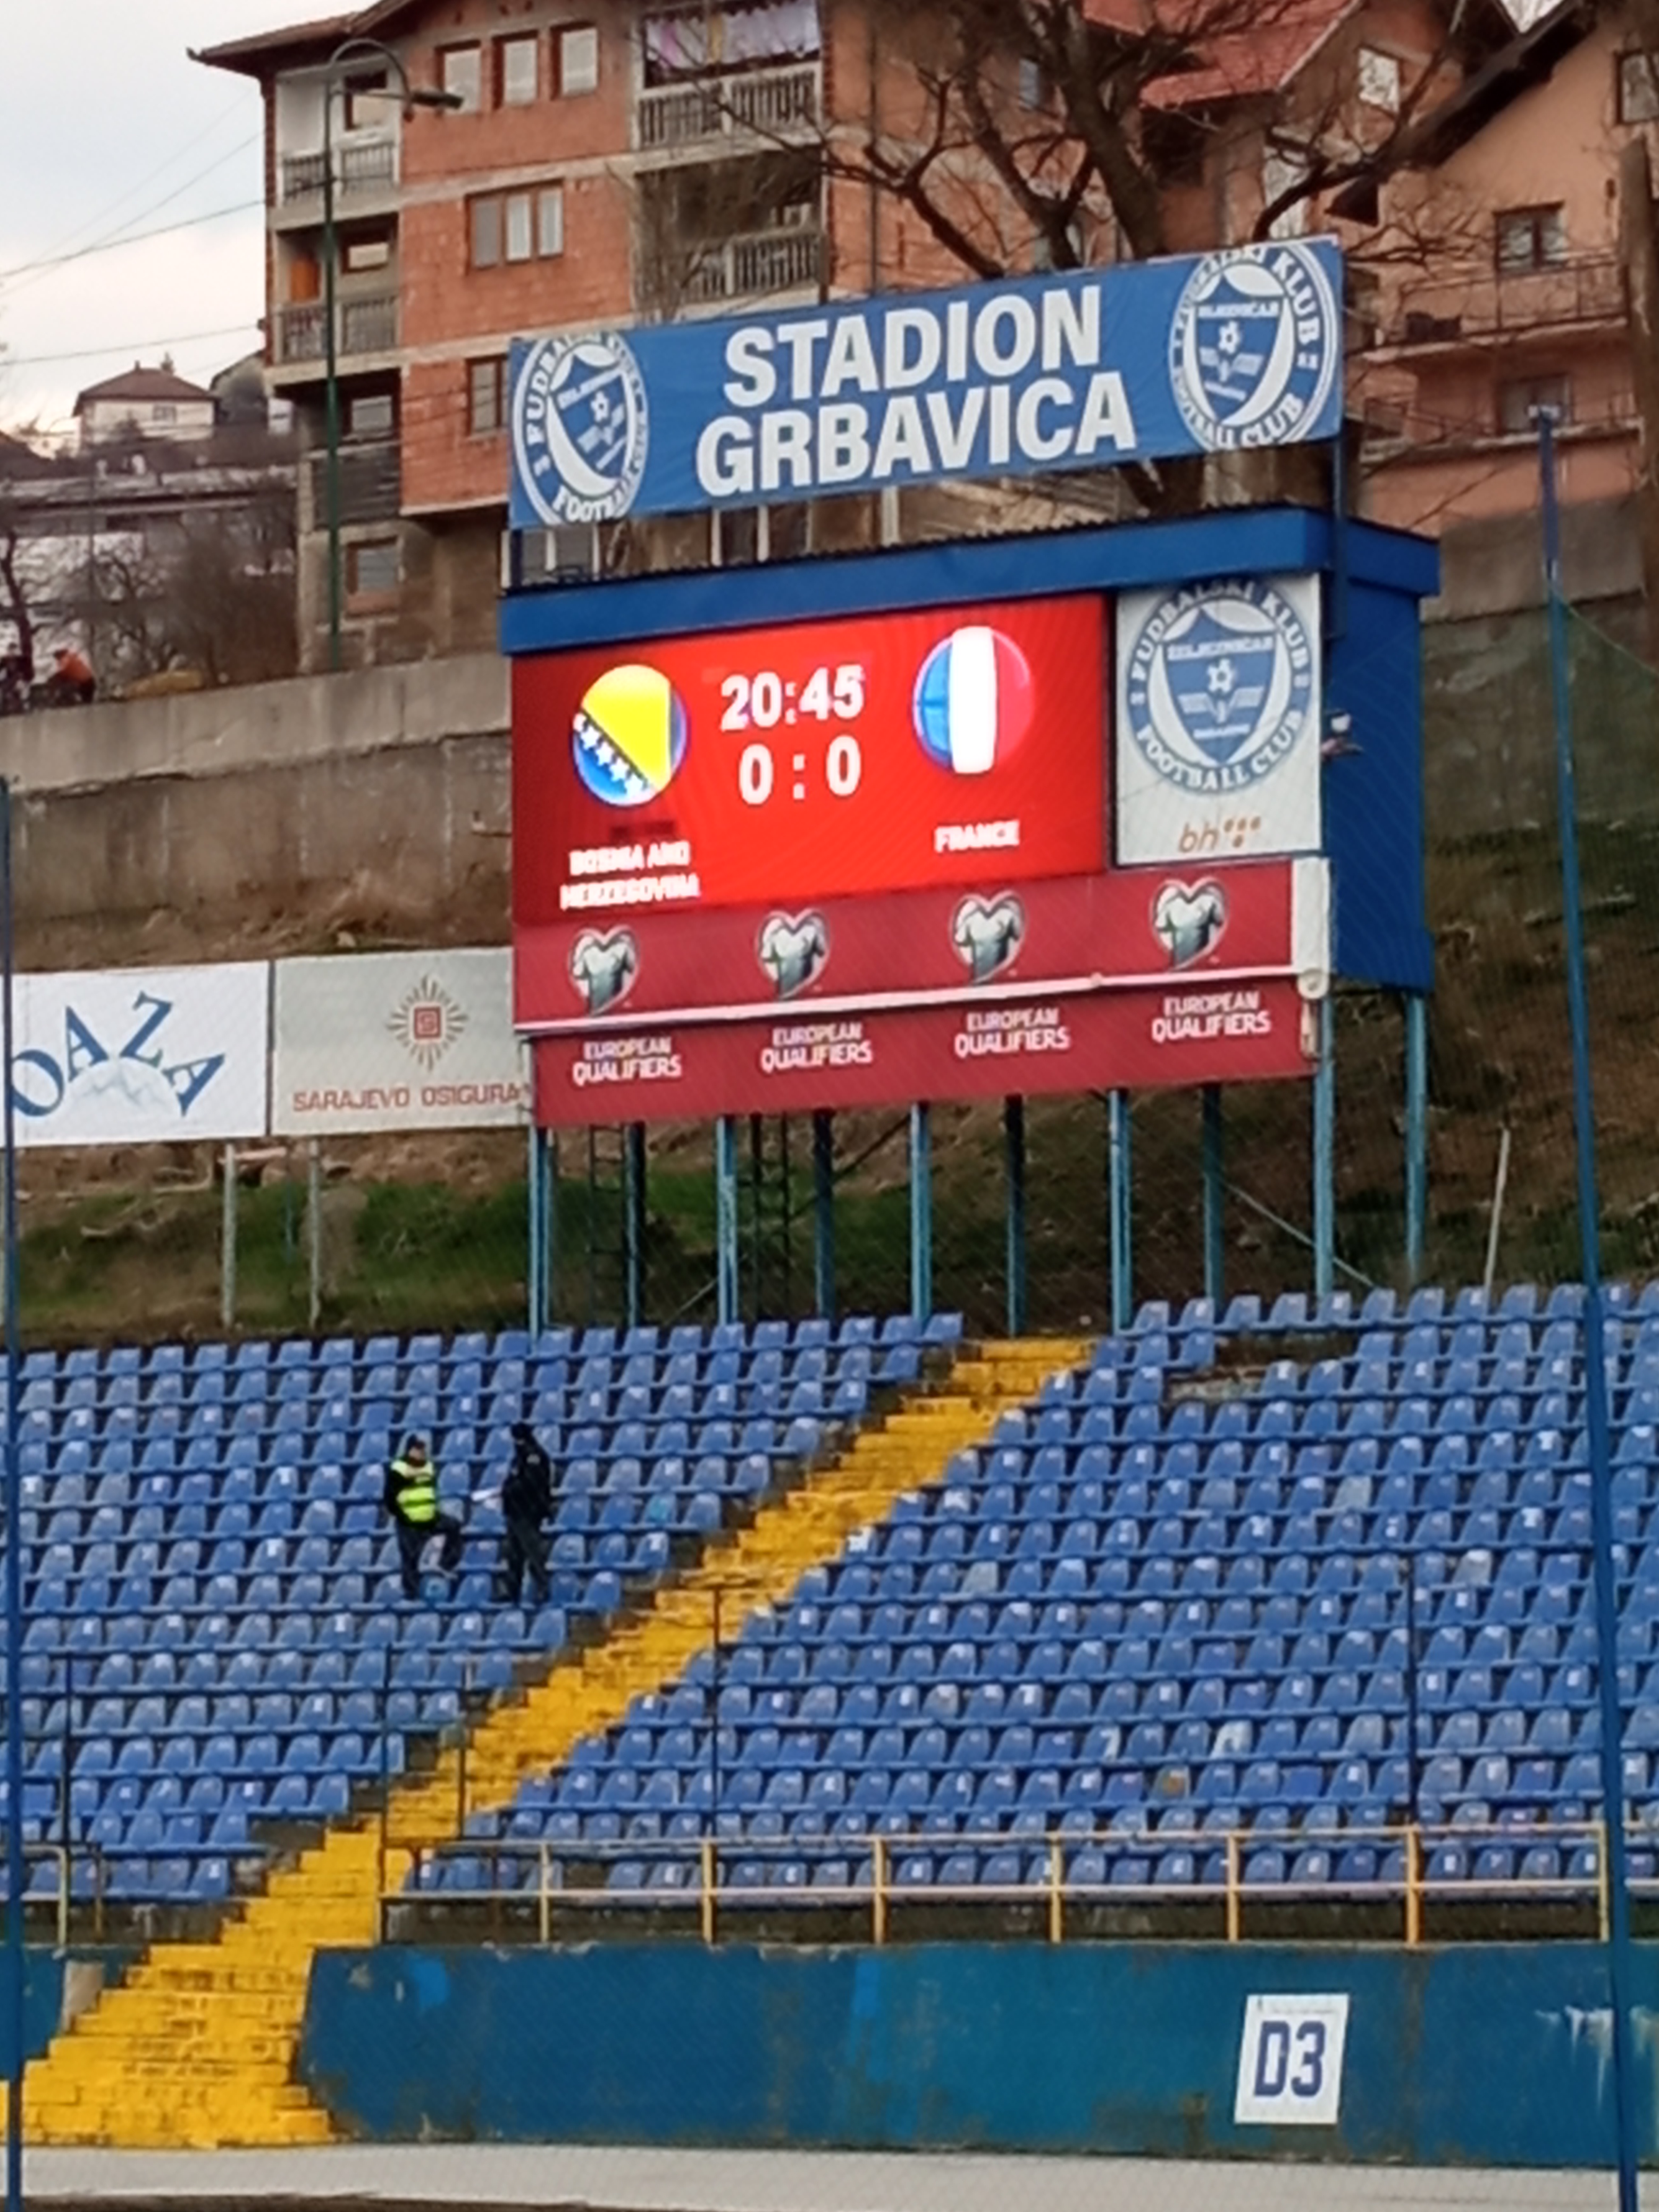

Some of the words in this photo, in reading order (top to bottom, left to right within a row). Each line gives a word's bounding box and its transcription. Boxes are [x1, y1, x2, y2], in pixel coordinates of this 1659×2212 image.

[1272, 252, 1320, 345] KLUB
[723, 286, 1101, 407] STADION
[696, 371, 1137, 497] GRBAVICA
[1241, 392, 1304, 448] CLUB
[1261, 591, 1310, 669] KLUB
[719, 664, 866, 733] 20:45
[1136, 724, 1250, 791] FOOTBALL
[1251, 710, 1303, 775] CLUB
[934, 819, 1020, 853] FRANCE
[569, 843, 645, 876] BOSNIA
[647, 840, 691, 869] AND
[559, 872, 702, 911] HERZEGOVINA
[966, 1008, 1060, 1032] EUROPEAN
[1164, 992, 1260, 1016] EUROPEAN
[772, 1023, 862, 1048] EUROPEAN
[954, 1026, 1070, 1058] QUALIFIERS
[1152, 1011, 1271, 1043] QUALIFIERS
[12, 991, 226, 1117] OAZA
[584, 1037, 672, 1059] EUROPEAN
[760, 1040, 873, 1074] QUALIFIERS
[572, 1055, 682, 1086] QUALIFIERS
[293, 1086, 410, 1112] SARAJEVO
[1254, 2020, 1326, 2098] D3
